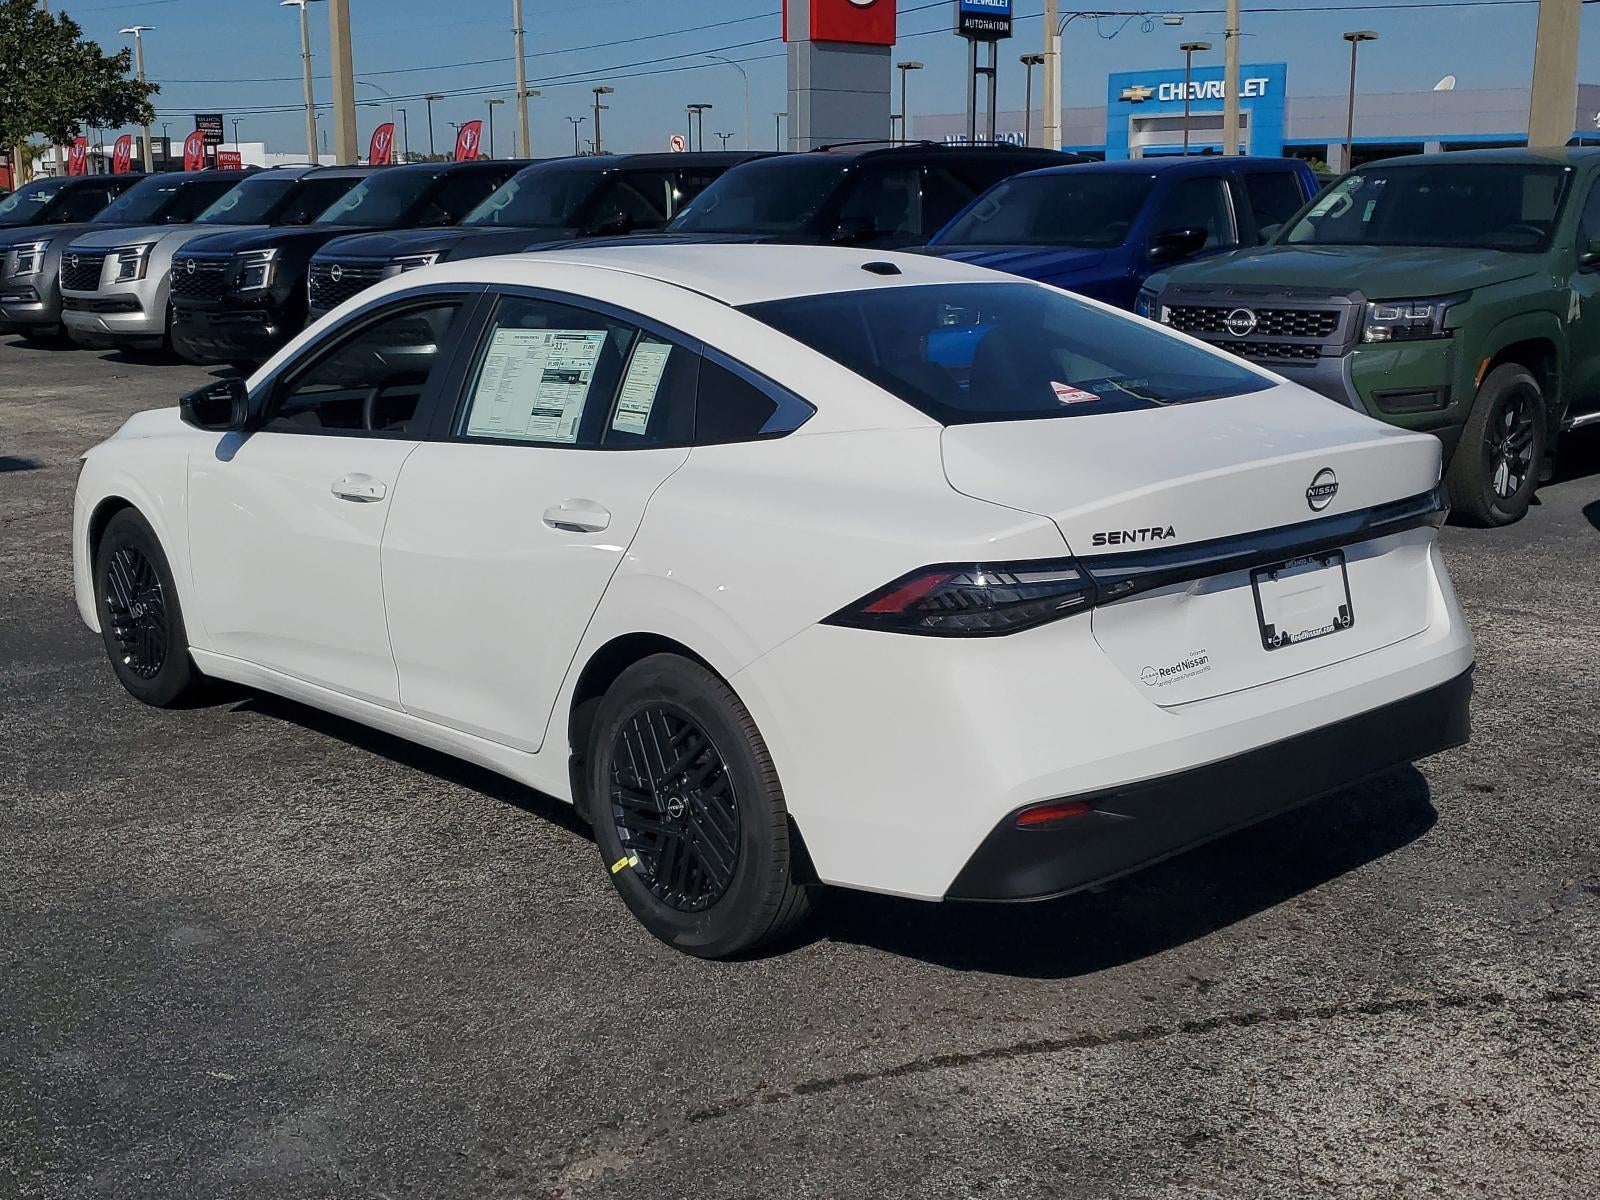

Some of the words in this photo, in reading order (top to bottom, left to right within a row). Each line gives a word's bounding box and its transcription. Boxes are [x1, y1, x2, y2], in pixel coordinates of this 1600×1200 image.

[965, 19, 1009, 31] AUTONATION
[219, 153, 241, 162] WRONG
[1223, 319, 1257, 327] NISSAN
[1092, 525, 1176, 546] SENTRA
